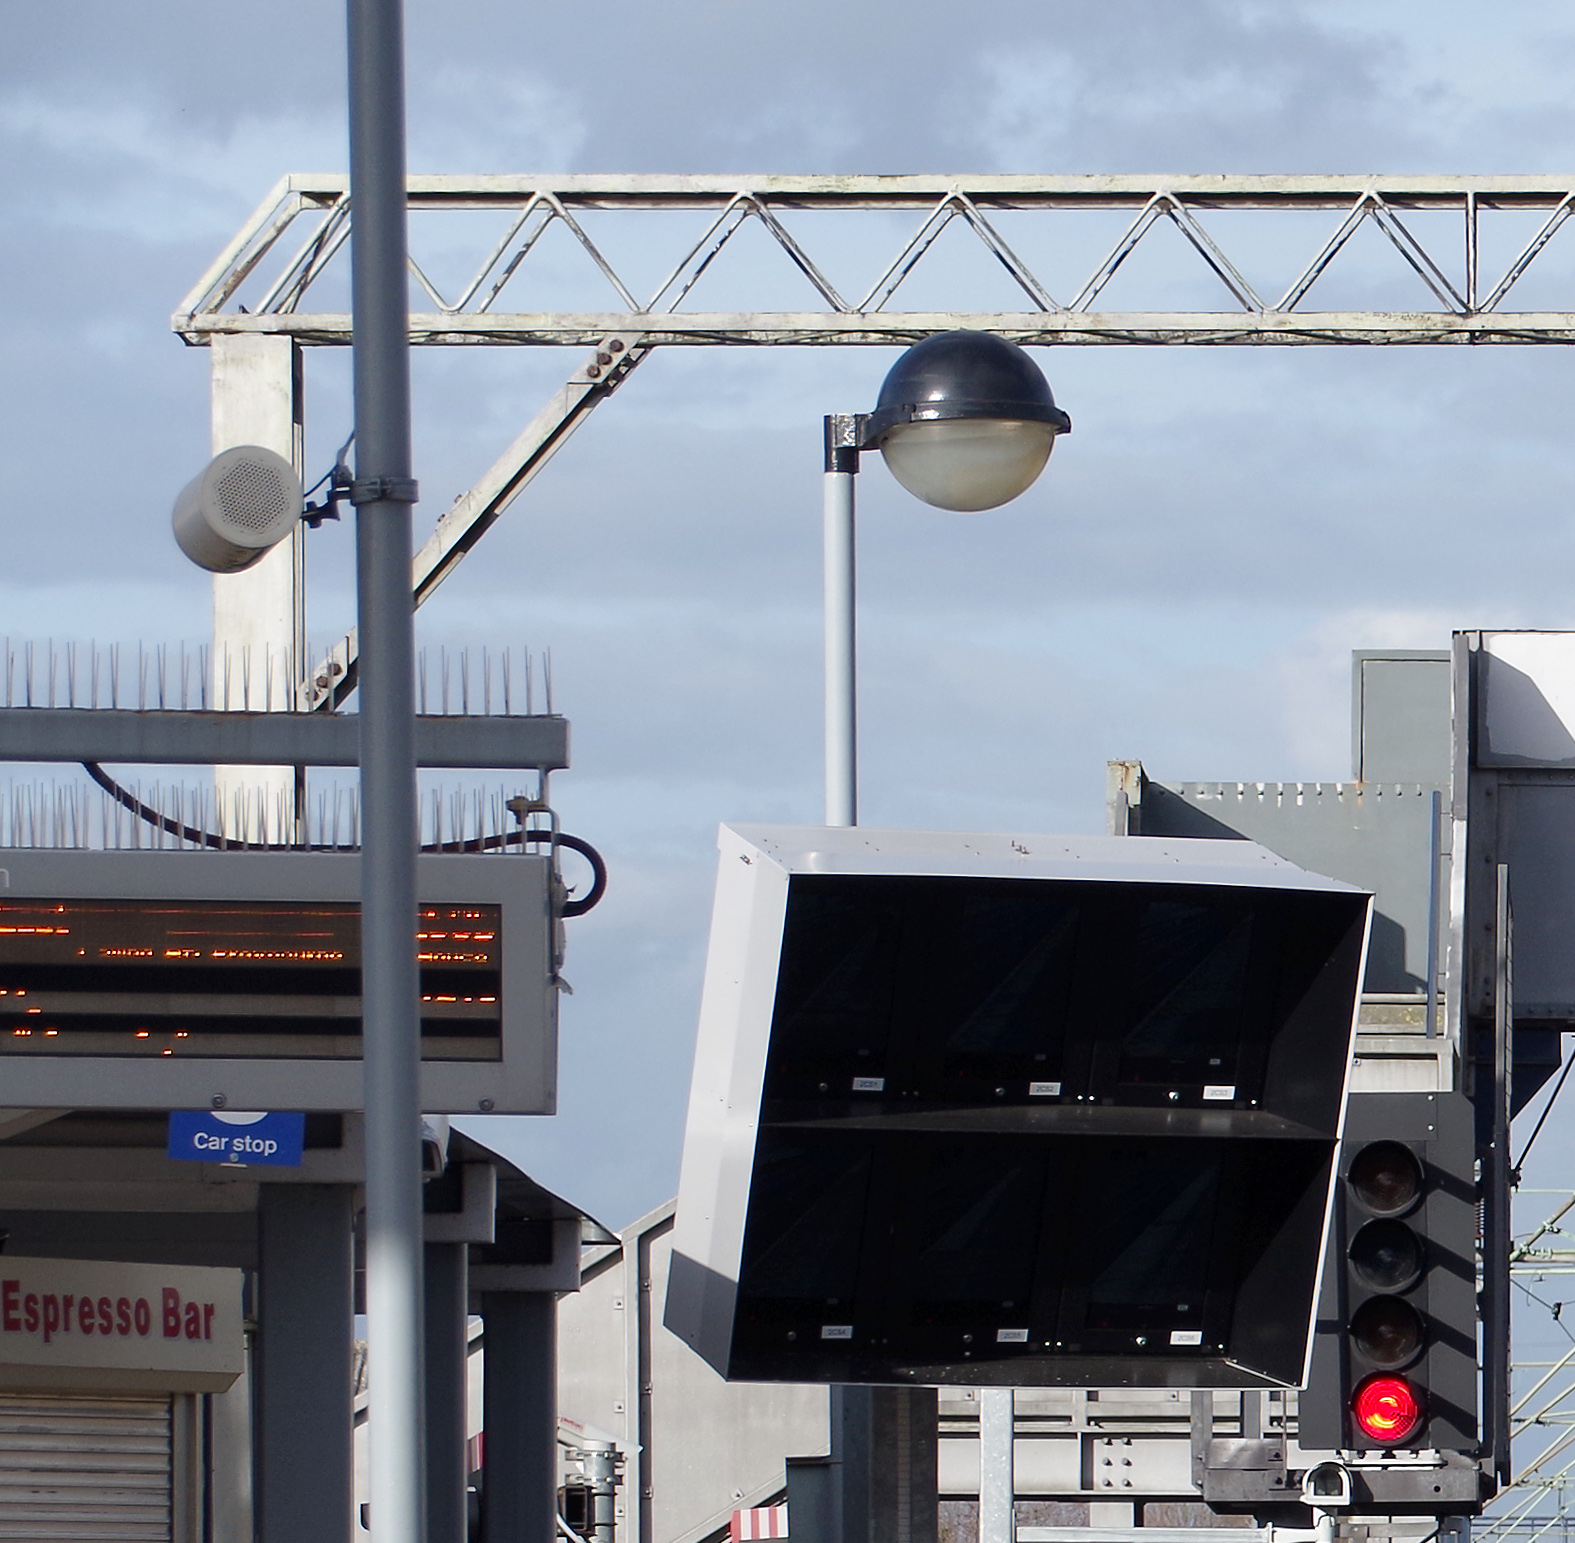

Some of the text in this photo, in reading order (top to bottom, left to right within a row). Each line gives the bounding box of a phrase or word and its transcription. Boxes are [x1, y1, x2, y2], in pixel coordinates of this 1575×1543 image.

[194, 1132, 278, 1156] Car stop
[2, 1280, 215, 1343] Espresso Bar
